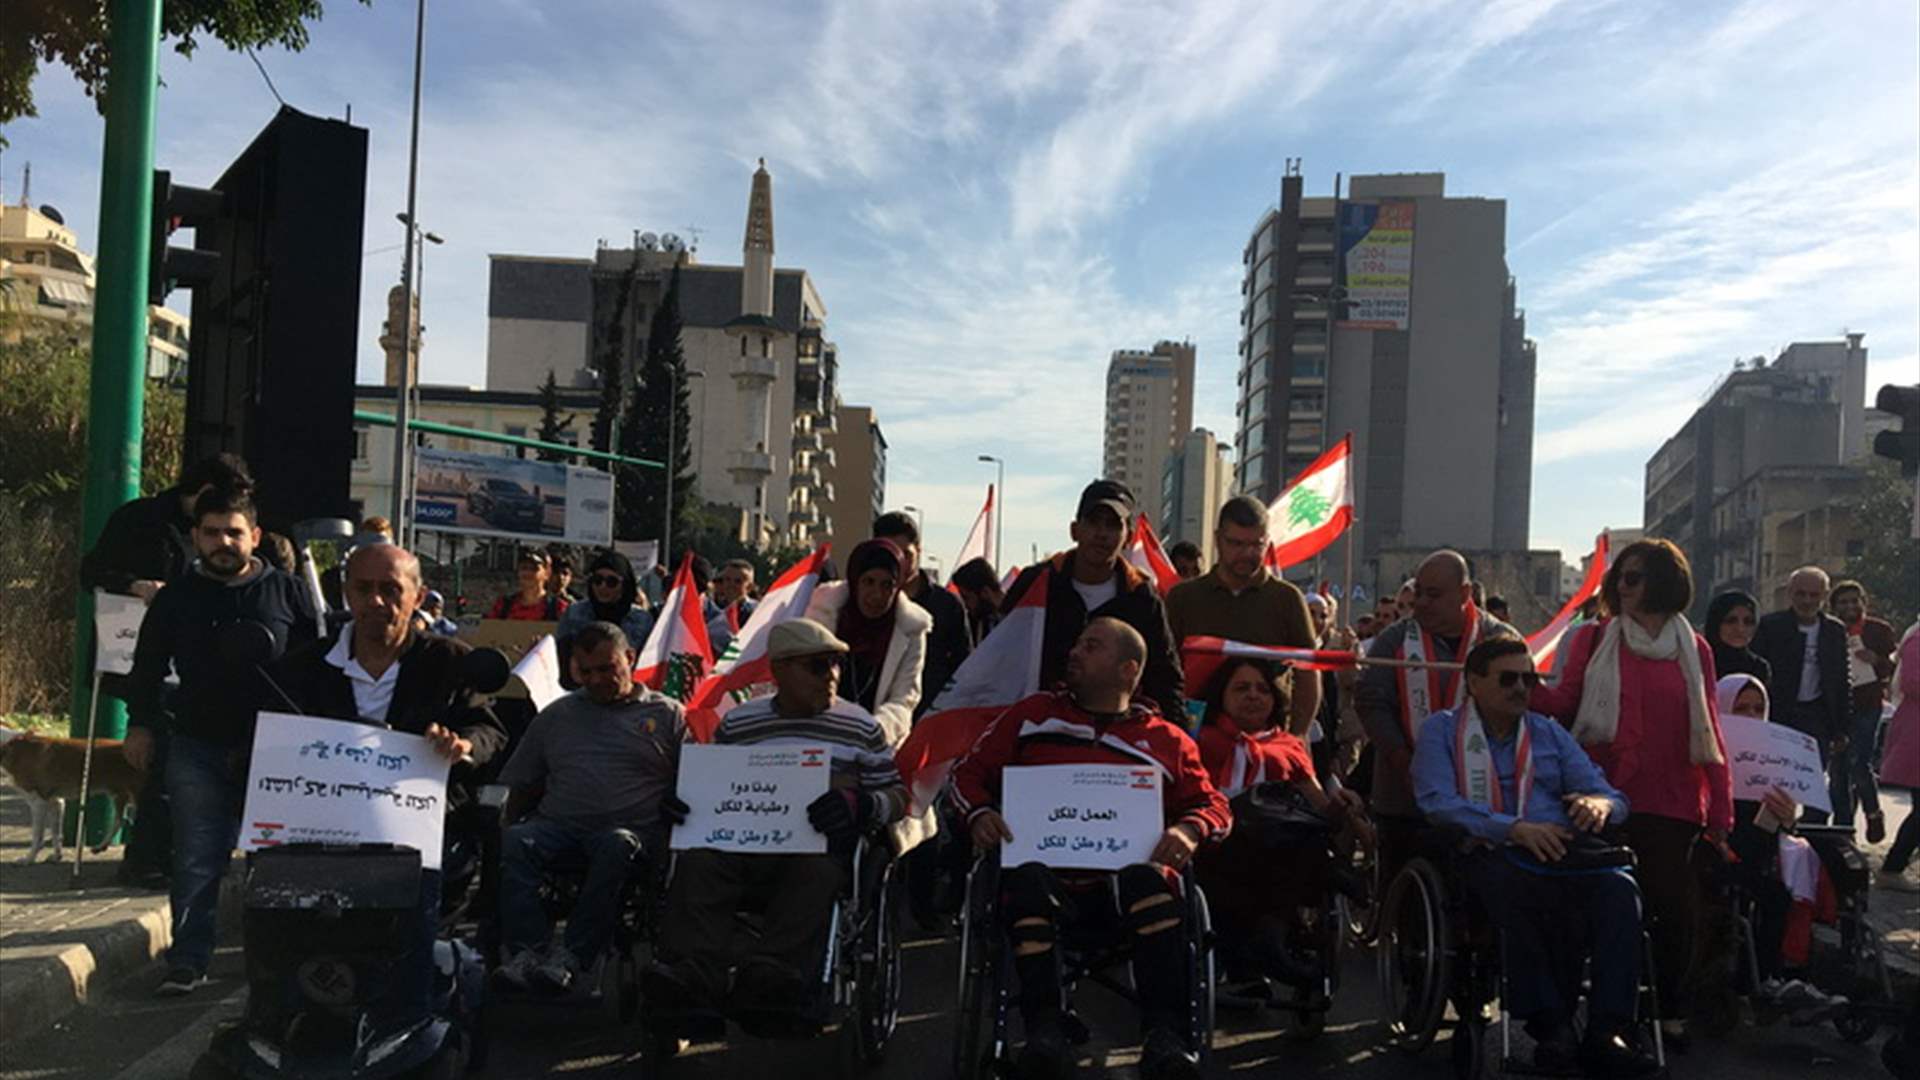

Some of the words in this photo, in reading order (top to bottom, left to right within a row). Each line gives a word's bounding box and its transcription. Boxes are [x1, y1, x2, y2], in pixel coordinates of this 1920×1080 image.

[376, 753, 411, 771] للكل
[258, 775, 328, 798] المشاركة
[404, 794, 438, 811] للكل
[714, 800, 743, 816] للكل
[1048, 805, 1078, 823] للكل
[1080, 808, 1119, 823] العمل
[705, 828, 735, 844] للكل
[1037, 834, 1068, 851] للكل
